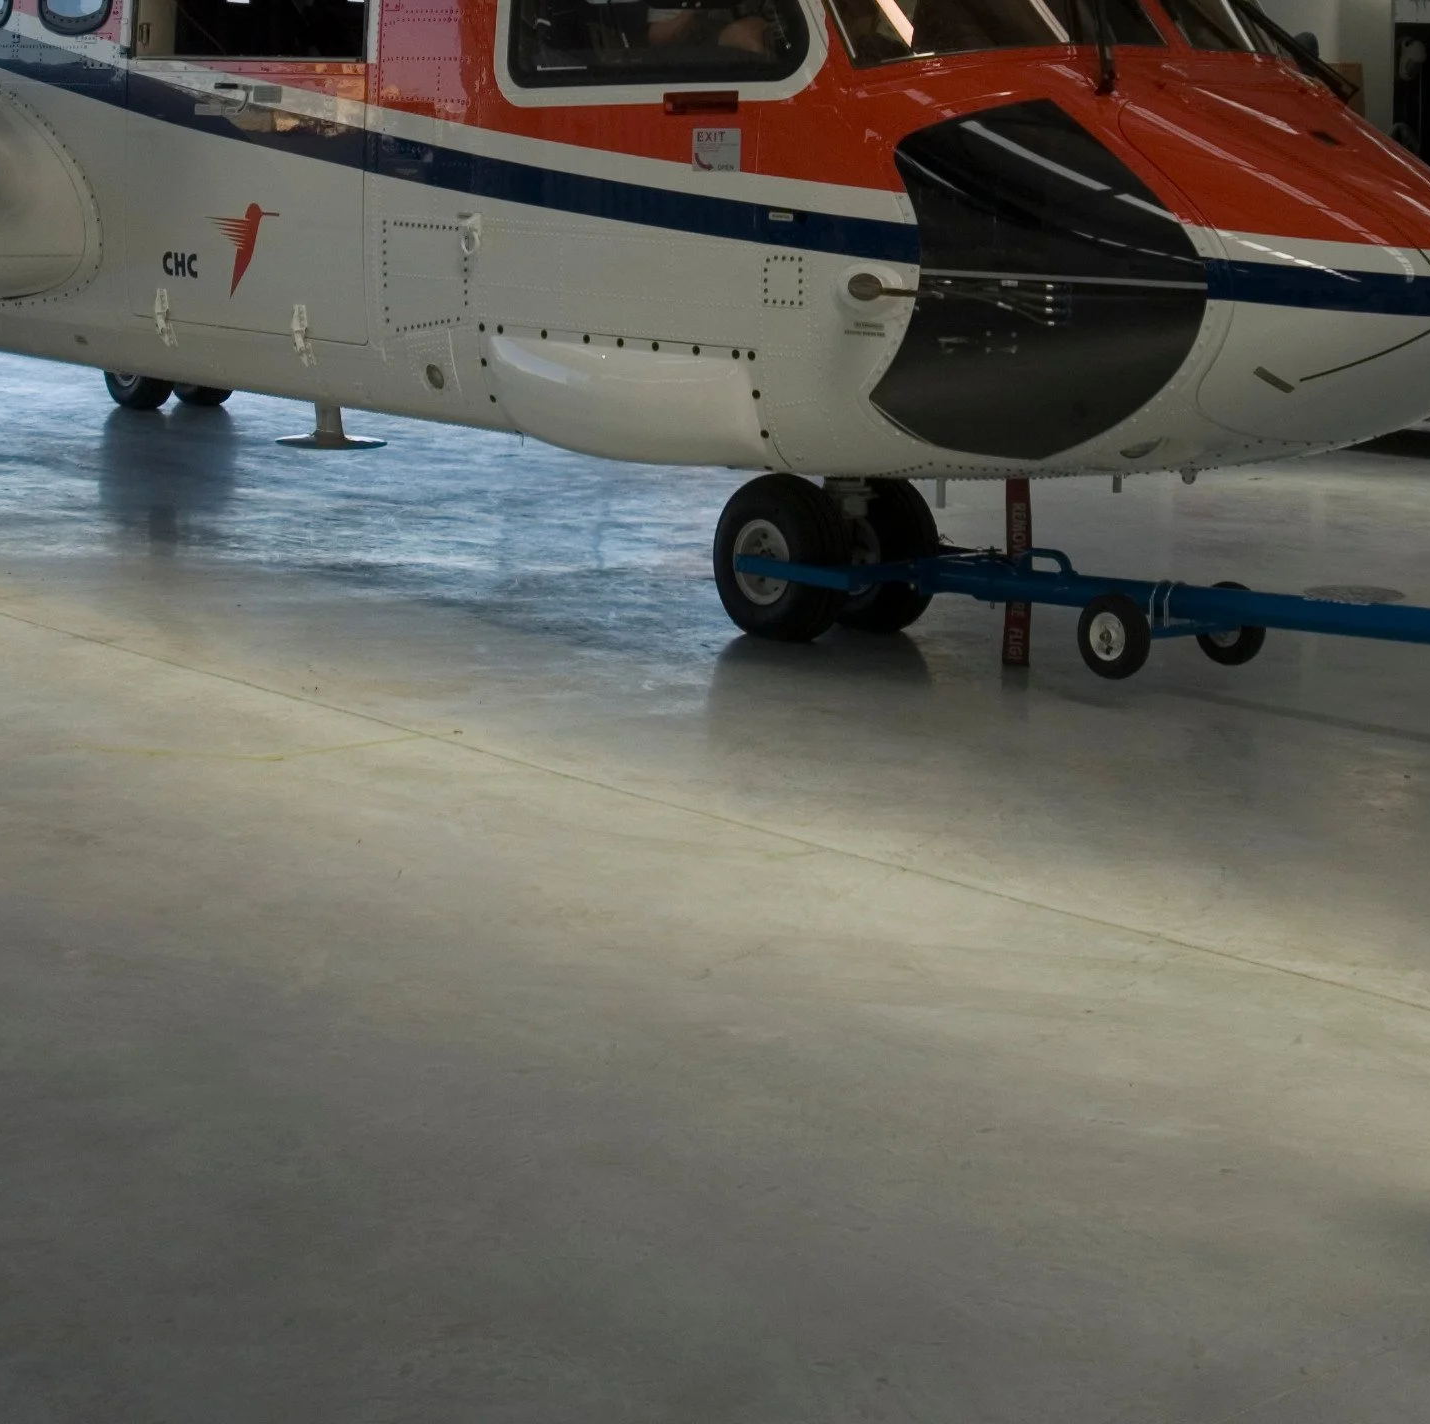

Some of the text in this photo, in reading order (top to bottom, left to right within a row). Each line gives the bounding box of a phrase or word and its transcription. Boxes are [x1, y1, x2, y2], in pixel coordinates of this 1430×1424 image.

[697, 131, 726, 143] EXIT
[717, 163, 735, 171] OPEN
[162, 251, 199, 279] CHC
